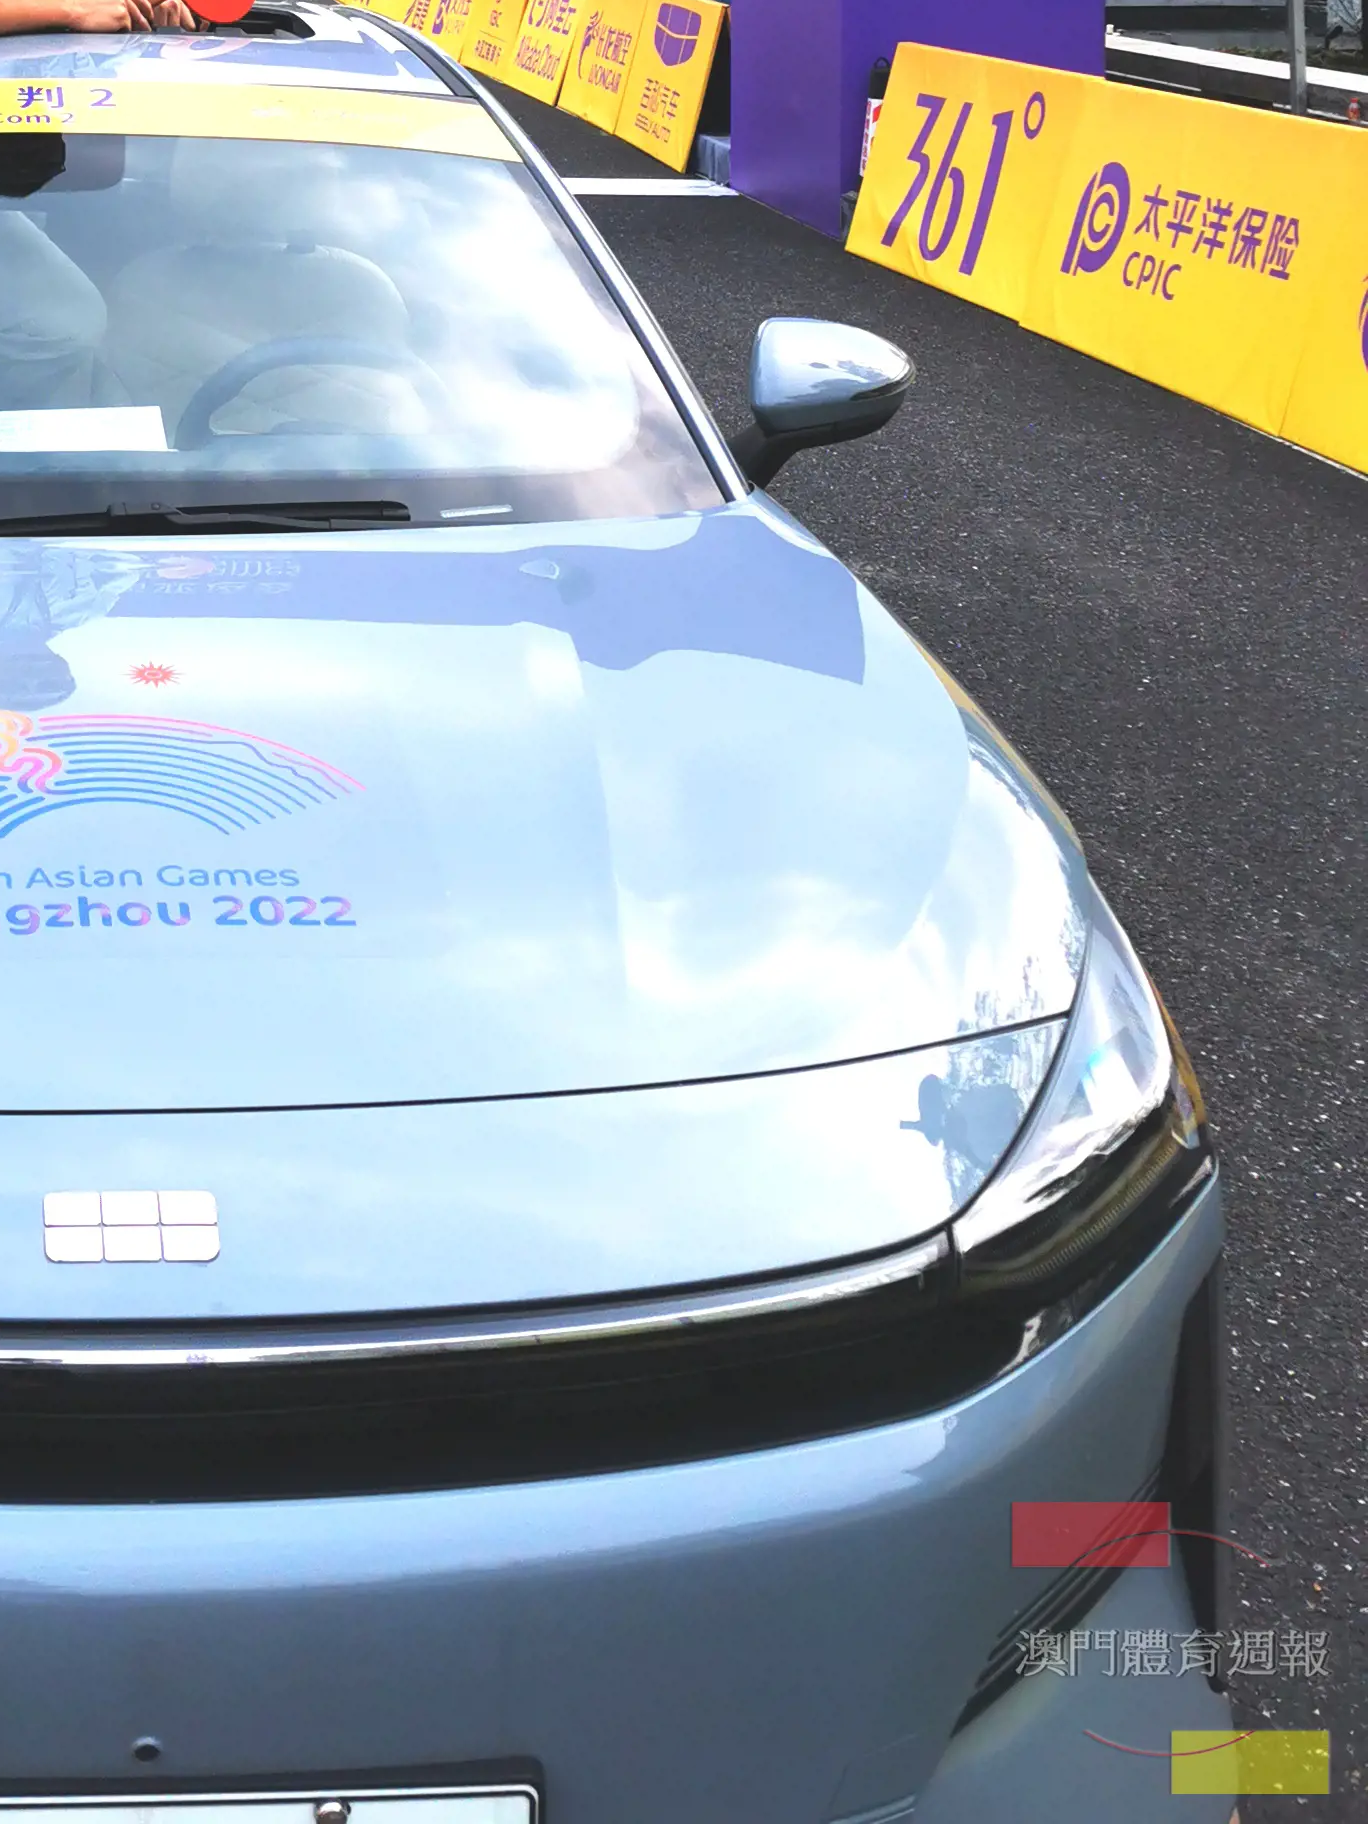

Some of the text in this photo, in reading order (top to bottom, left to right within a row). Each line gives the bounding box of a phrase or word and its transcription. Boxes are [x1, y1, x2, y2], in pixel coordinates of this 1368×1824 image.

[60, 112, 76, 124] 2
[881, 90, 1046, 276] 361°
[1133, 184, 1301, 281] 太平洋保险
[1122, 251, 1183, 301] CPIC
[25, 864, 143, 889] Asian
[156, 863, 300, 887] Games
[211, 894, 358, 928] 2022
